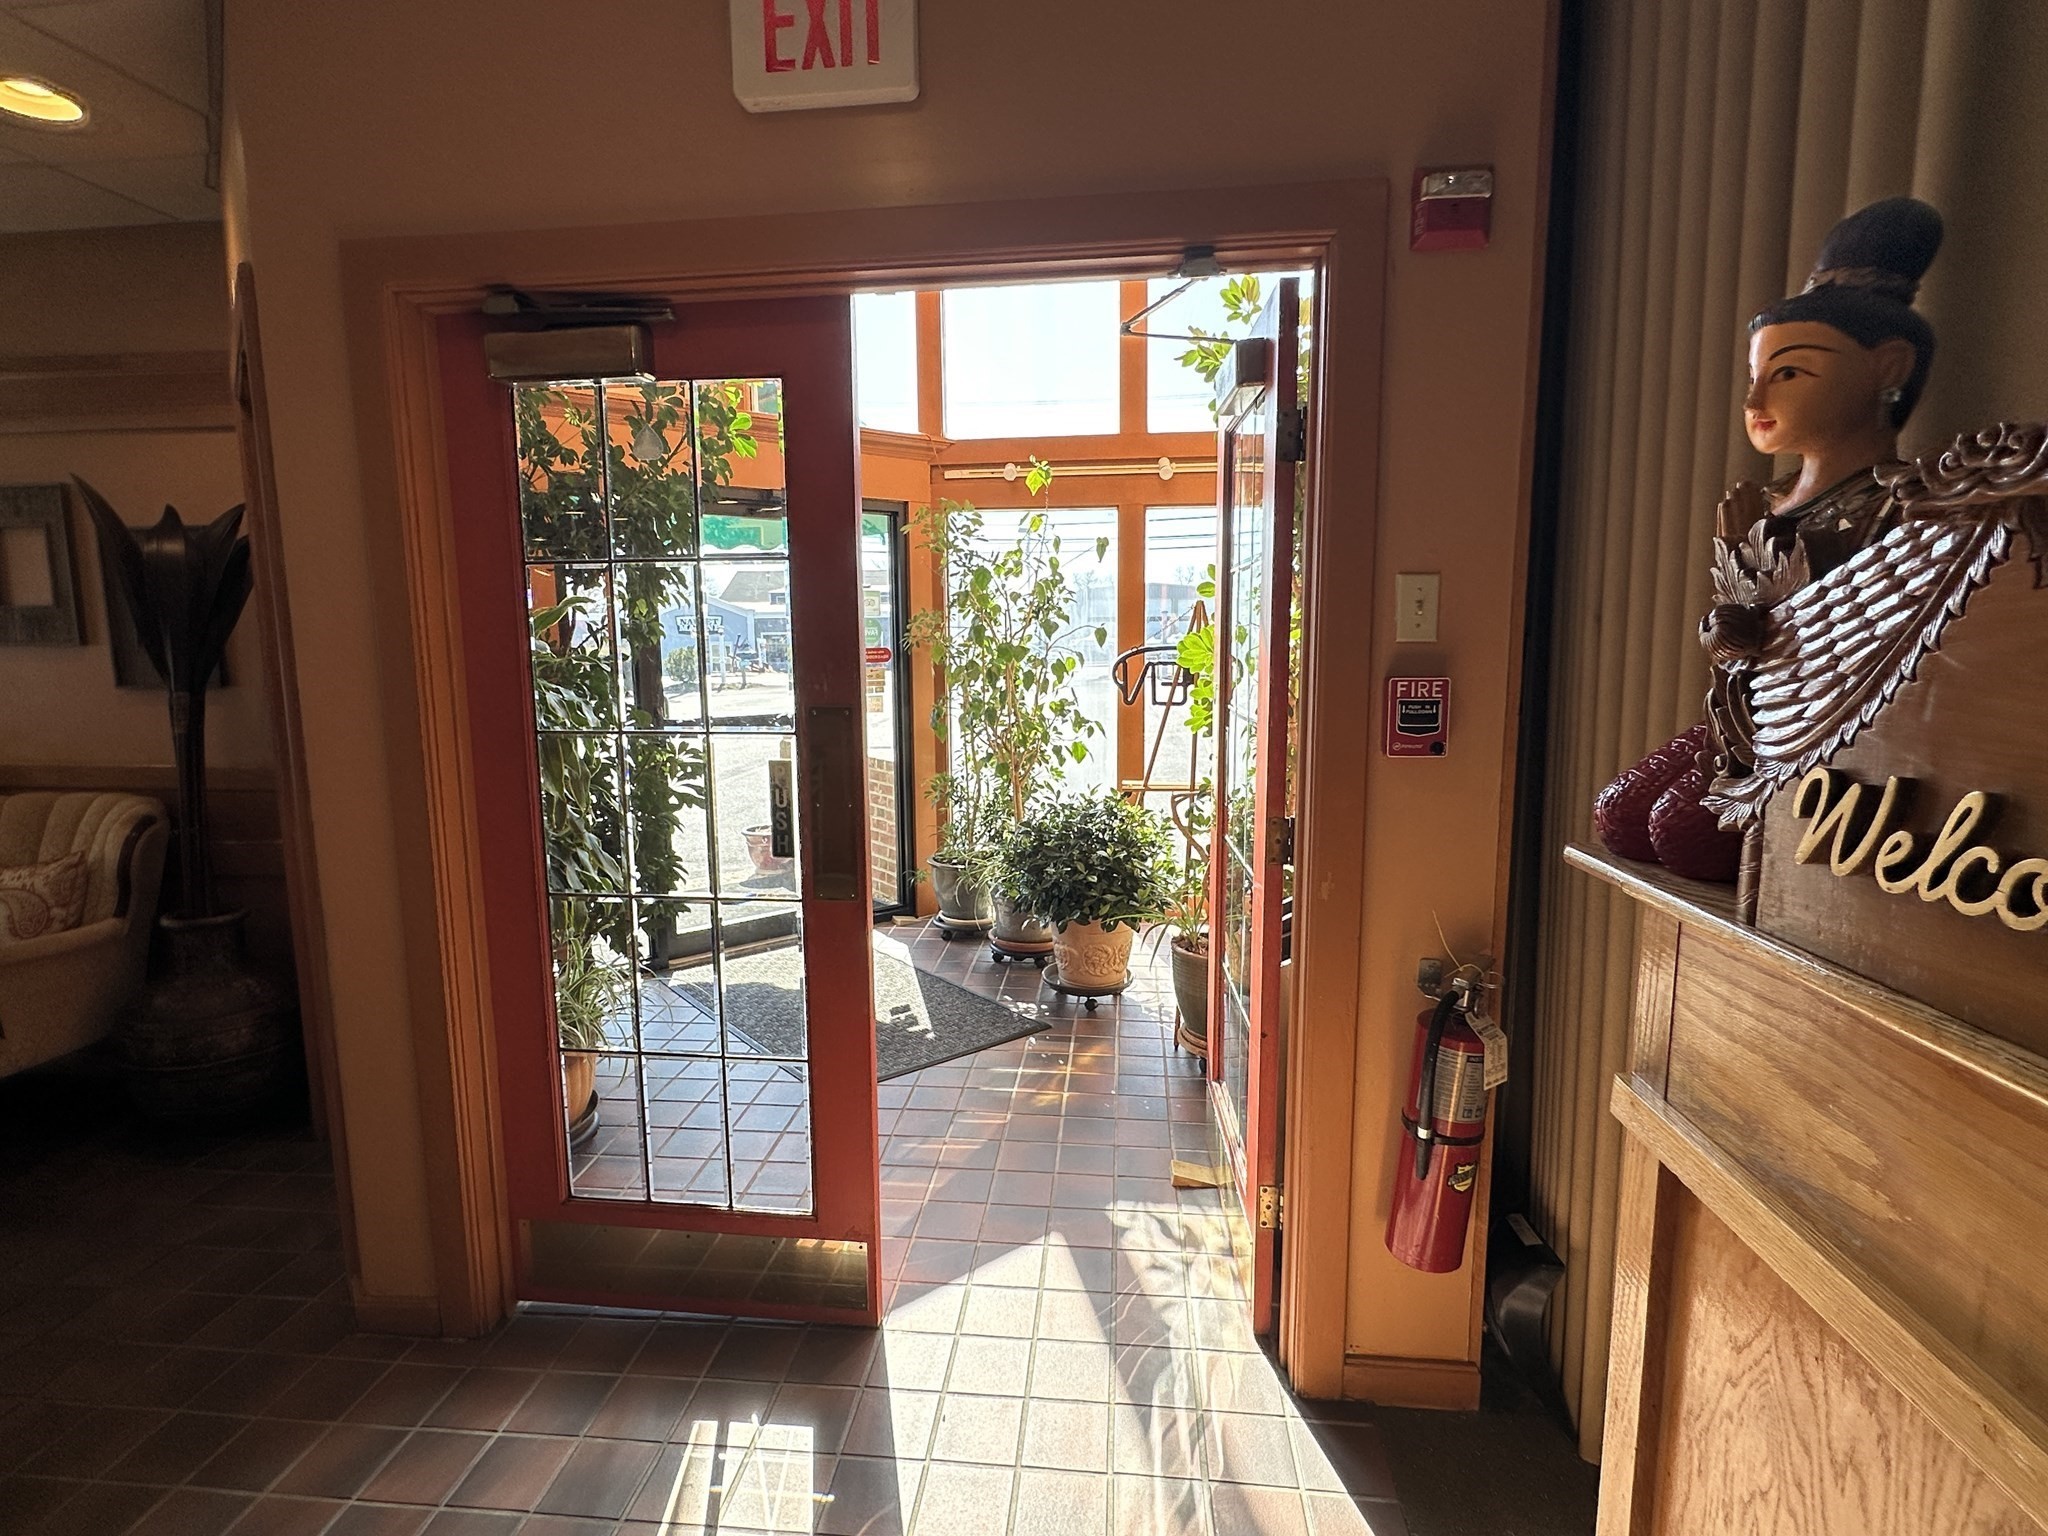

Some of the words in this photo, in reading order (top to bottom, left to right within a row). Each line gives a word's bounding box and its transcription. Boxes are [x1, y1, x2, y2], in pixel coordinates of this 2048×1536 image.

[763, 0, 881, 72] EXIT
[1396, 681, 1443, 698] FIRE
[774, 765, 789, 853] PUSH
